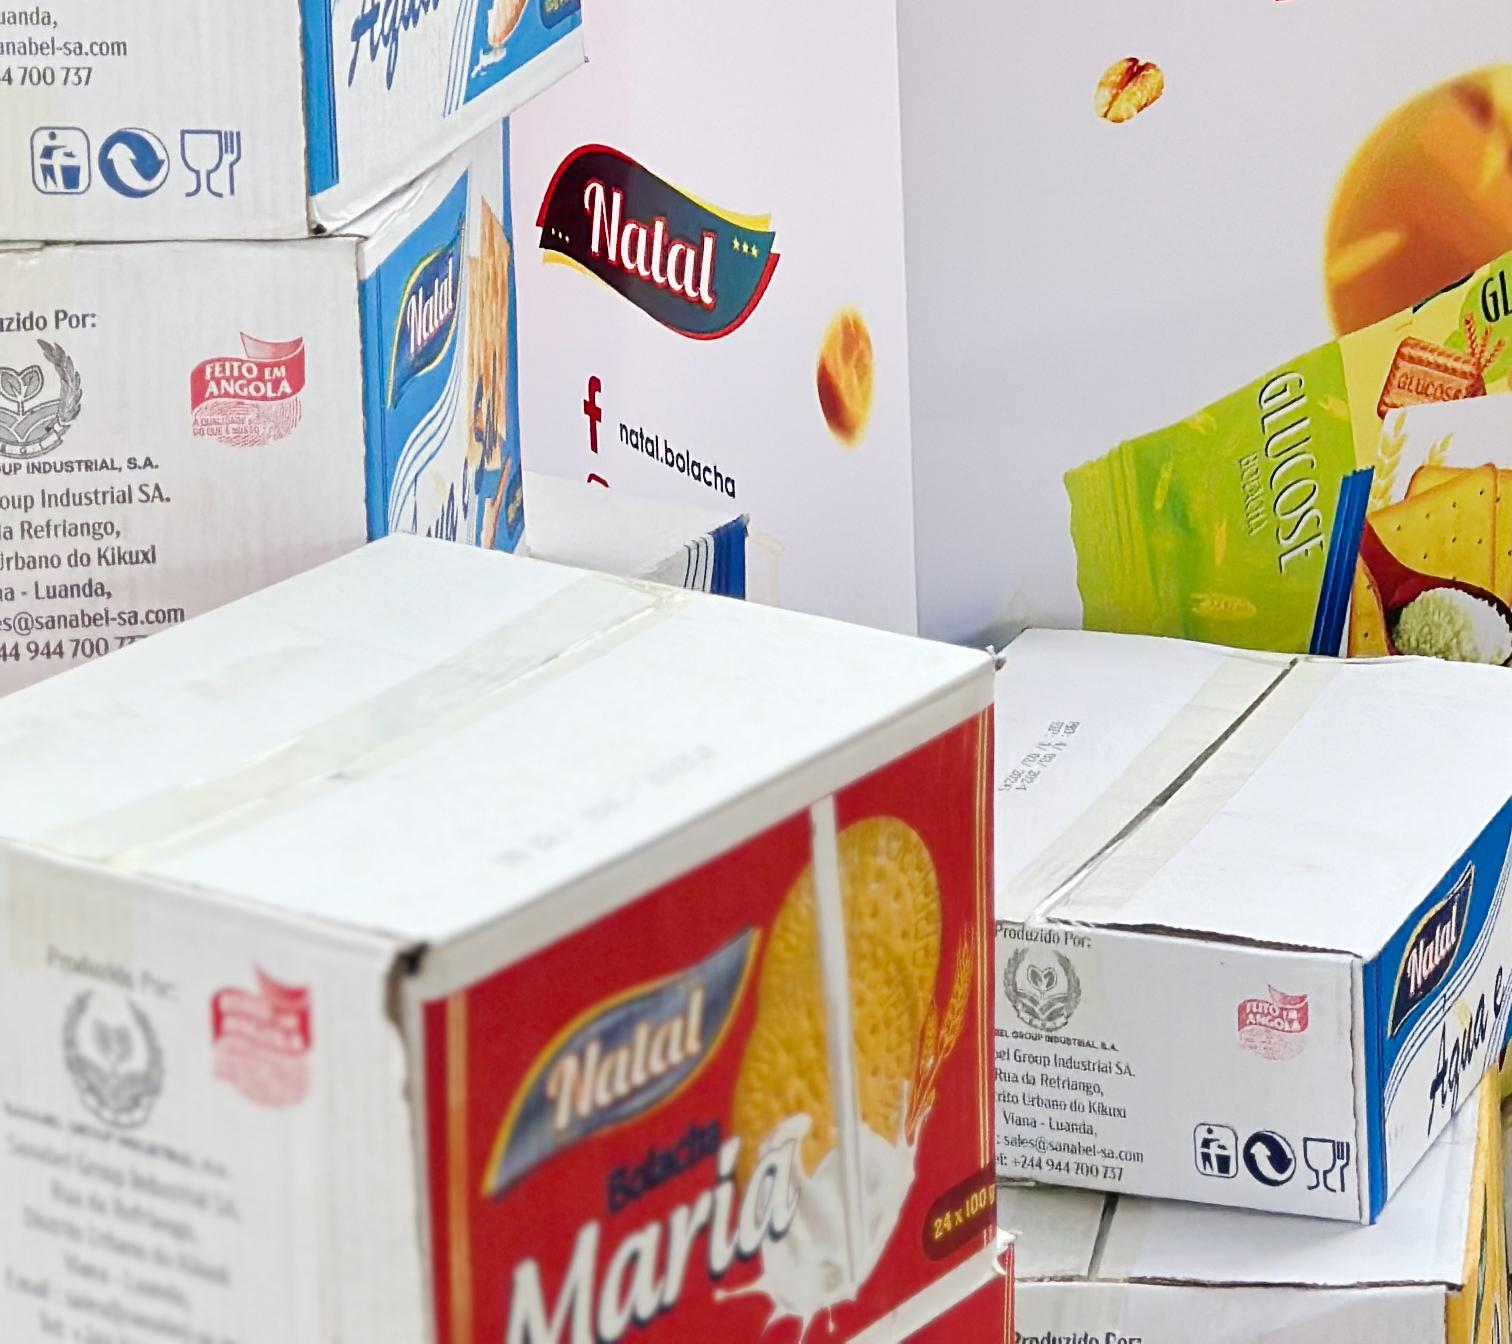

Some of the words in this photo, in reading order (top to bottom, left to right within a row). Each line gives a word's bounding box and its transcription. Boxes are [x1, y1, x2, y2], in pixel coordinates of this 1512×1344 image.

[20, 67, 56, 87] 700
[61, 67, 93, 87] 737
[583, 182, 716, 306] Natal
[54, 309, 97, 330] Por:
[406, 257, 454, 355] Natal
[204, 361, 258, 380] FEITO
[264, 365, 286, 380] EM
[204, 378, 292, 398] ANGOLA
[26, 459, 123, 475] INDUSTRIAL,
[126, 457, 159, 470] S.A.
[618, 420, 737, 500] natal.bolacha
[1258, 370, 1325, 576] GLUCOSE
[41, 485, 133, 509] Industrial
[138, 482, 172, 504] SA.
[20, 518, 122, 542] Refriango,
[67, 548, 92, 569] do
[97, 544, 157, 567] Kikuxi
[34, 578, 113, 600] Luanda,
[26, 640, 64, 661] 944
[70, 637, 109, 658] 700
[1064, 932, 1093, 949] Por:
[1406, 912, 1457, 995] Natal
[1493, 965, 1504, 1020] e
[547, 983, 707, 1133] Natal
[1013, 1048, 1051, 1068] Group
[1054, 1053, 1112, 1075] Industrial
[1115, 1061, 1136, 1077] SA.
[1021, 1071, 1036, 1087] da
[1040, 1073, 1104, 1097] Refriango,
[1022, 1092, 1067, 1112] Urbano
[1069, 1097, 1085, 1114] do
[1088, 1100, 1127, 1120] Kikuxi
[1002, 1110, 1037, 1129] Viana
[1049, 1116, 1098, 1137] Luanda,
[1003, 1134, 1144, 1164] sales@sanabel-sa.com
[606, 1118, 721, 1214] Bolacha
[1013, 1155, 1043, 1171] +244
[1045, 1158, 1070, 1174] 944
[1073, 1161, 1099, 1178] 700
[504, 1129, 803, 1344] Maria
[932, 1212, 953, 1241] 24
